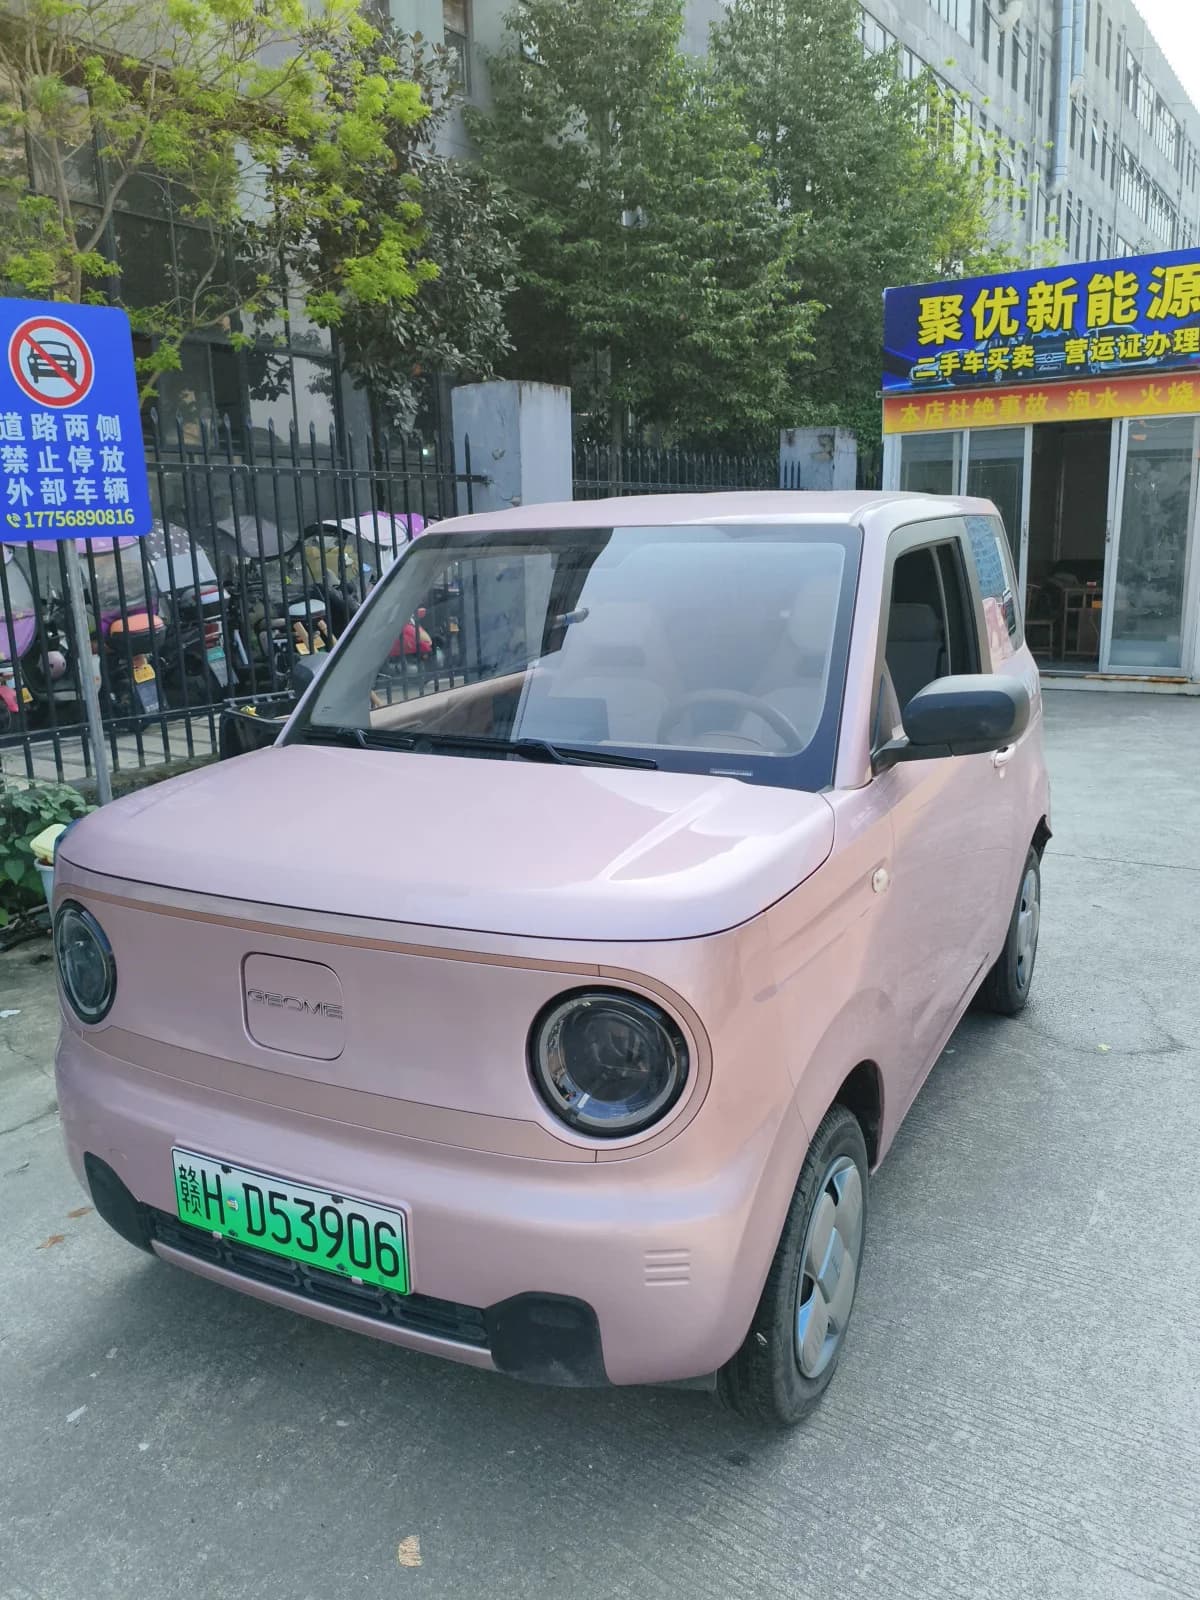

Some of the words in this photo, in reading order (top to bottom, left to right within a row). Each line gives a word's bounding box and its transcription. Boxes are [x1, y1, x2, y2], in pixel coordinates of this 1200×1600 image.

[917, 263, 1200, 345] 聚优新能源
[915, 345, 1035, 379] 二手车买卖
[1065, 327, 1200, 365] 营运证办理
[0, 412, 123, 443] 道路两侧
[1, 445, 127, 474] 禁止停放
[6, 477, 130, 507] 外部车辆
[24, 508, 135, 529] 17756890816
[247, 988, 343, 1020] GEOME
